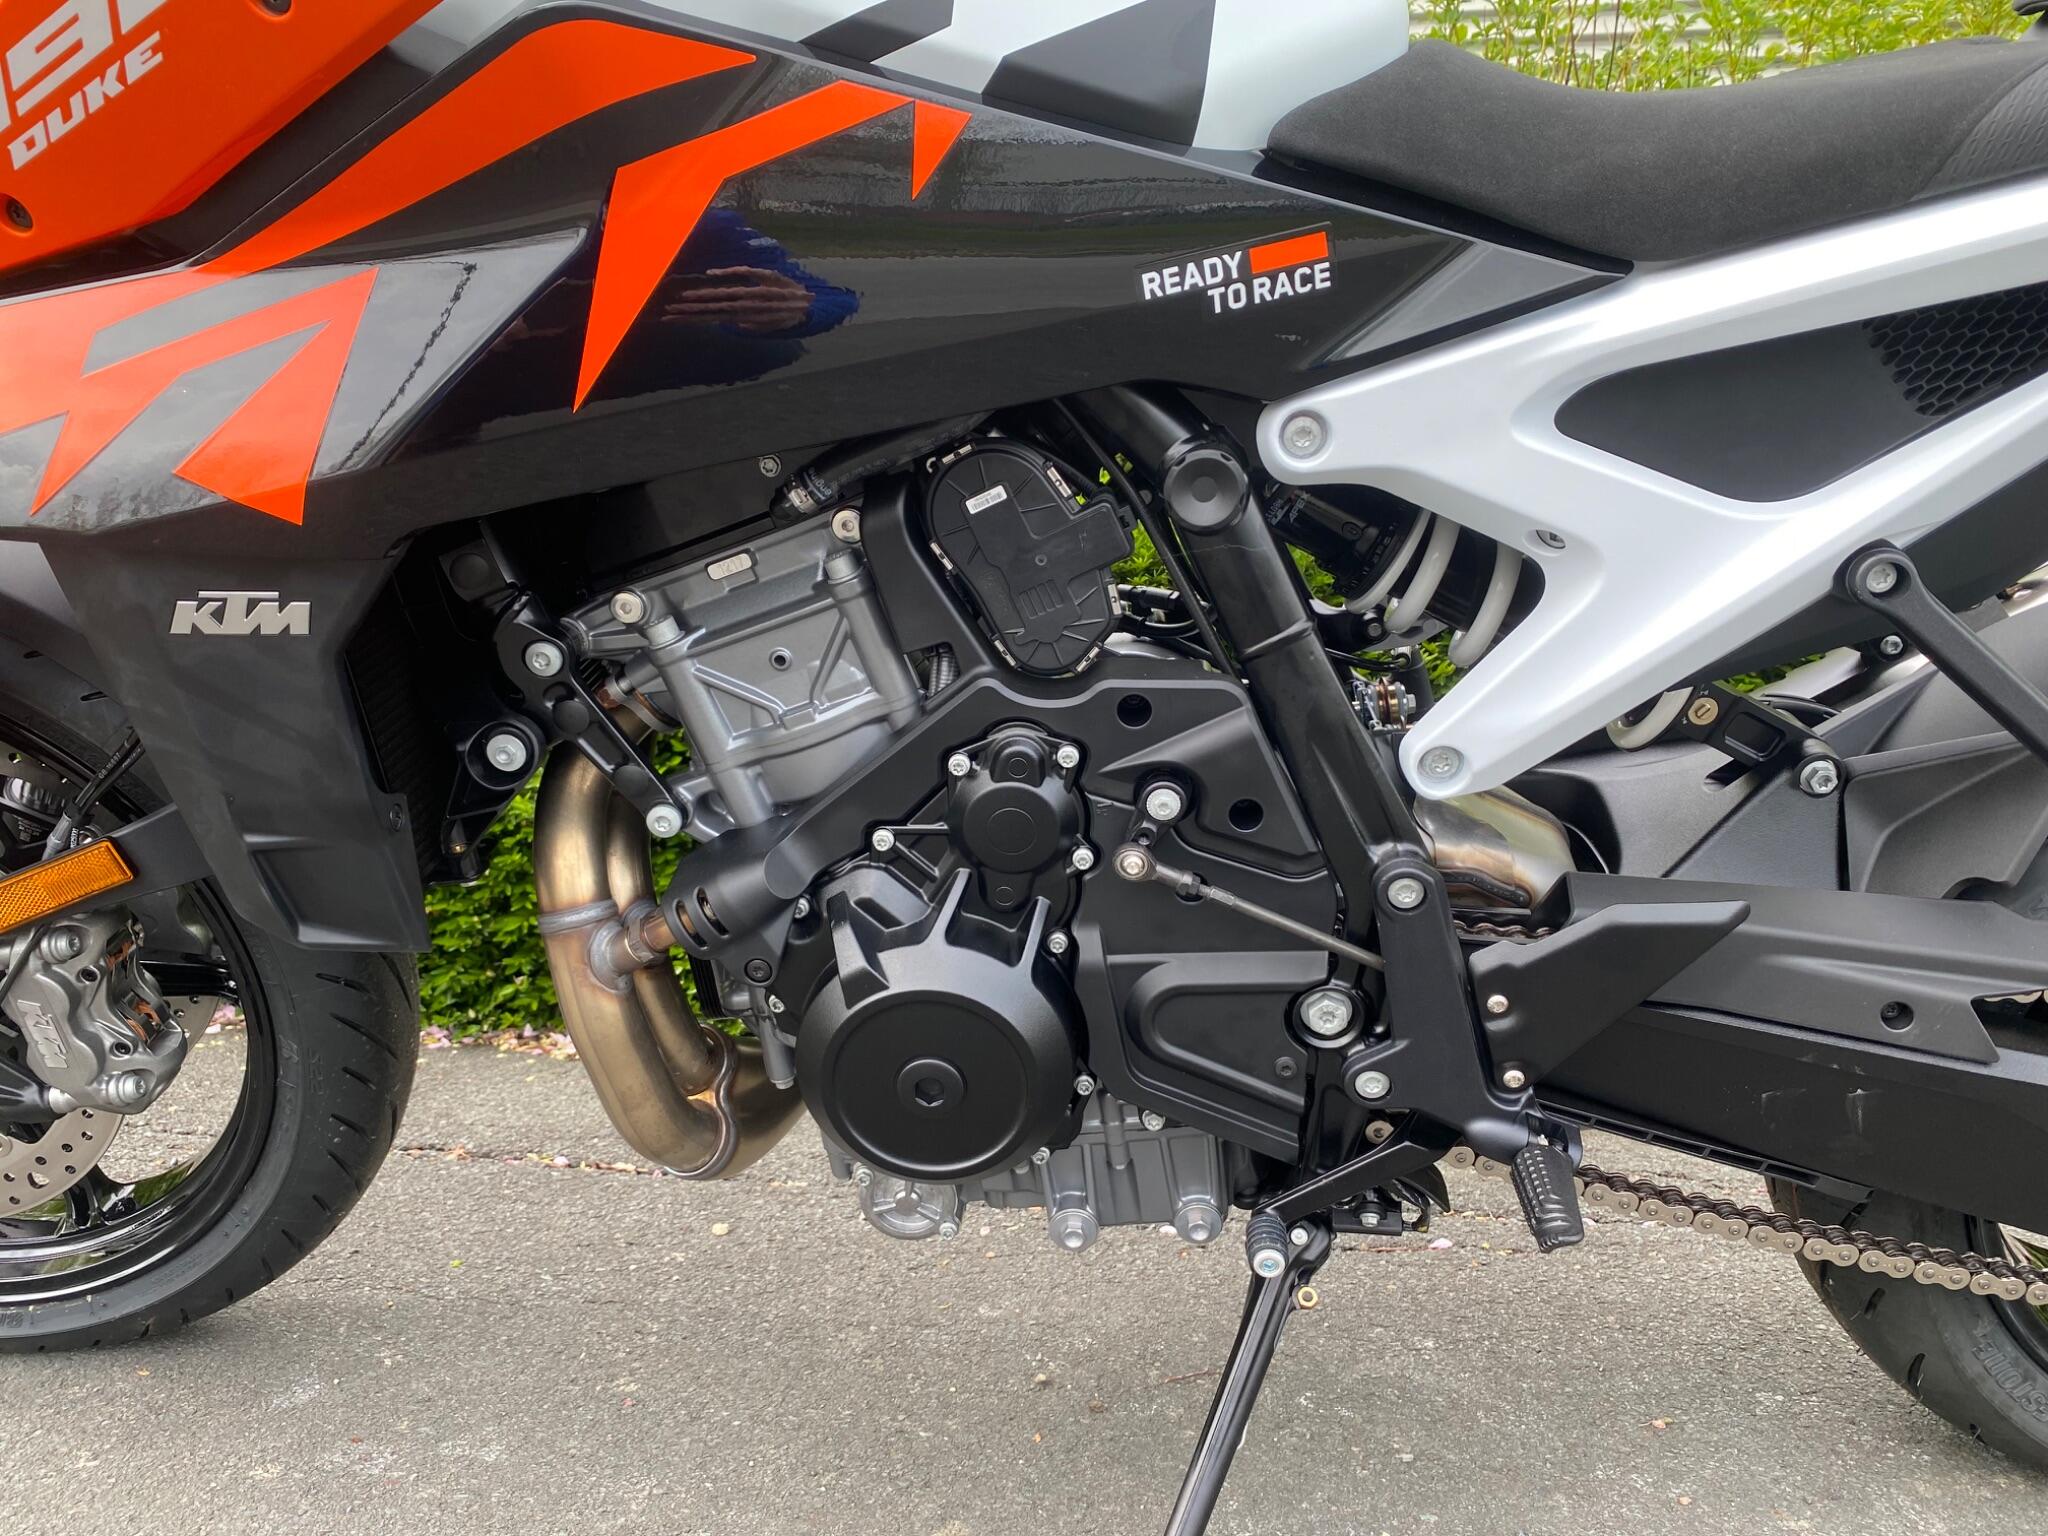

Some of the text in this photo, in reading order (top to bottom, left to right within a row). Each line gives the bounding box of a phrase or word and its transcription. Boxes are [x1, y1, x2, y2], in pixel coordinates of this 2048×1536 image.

[7, 31, 163, 170] DUKE
[1141, 251, 1242, 300] READY
[1207, 261, 1332, 314] TO RACE
[169, 590, 311, 635] KTM
[16, 999, 69, 1069] KTM
